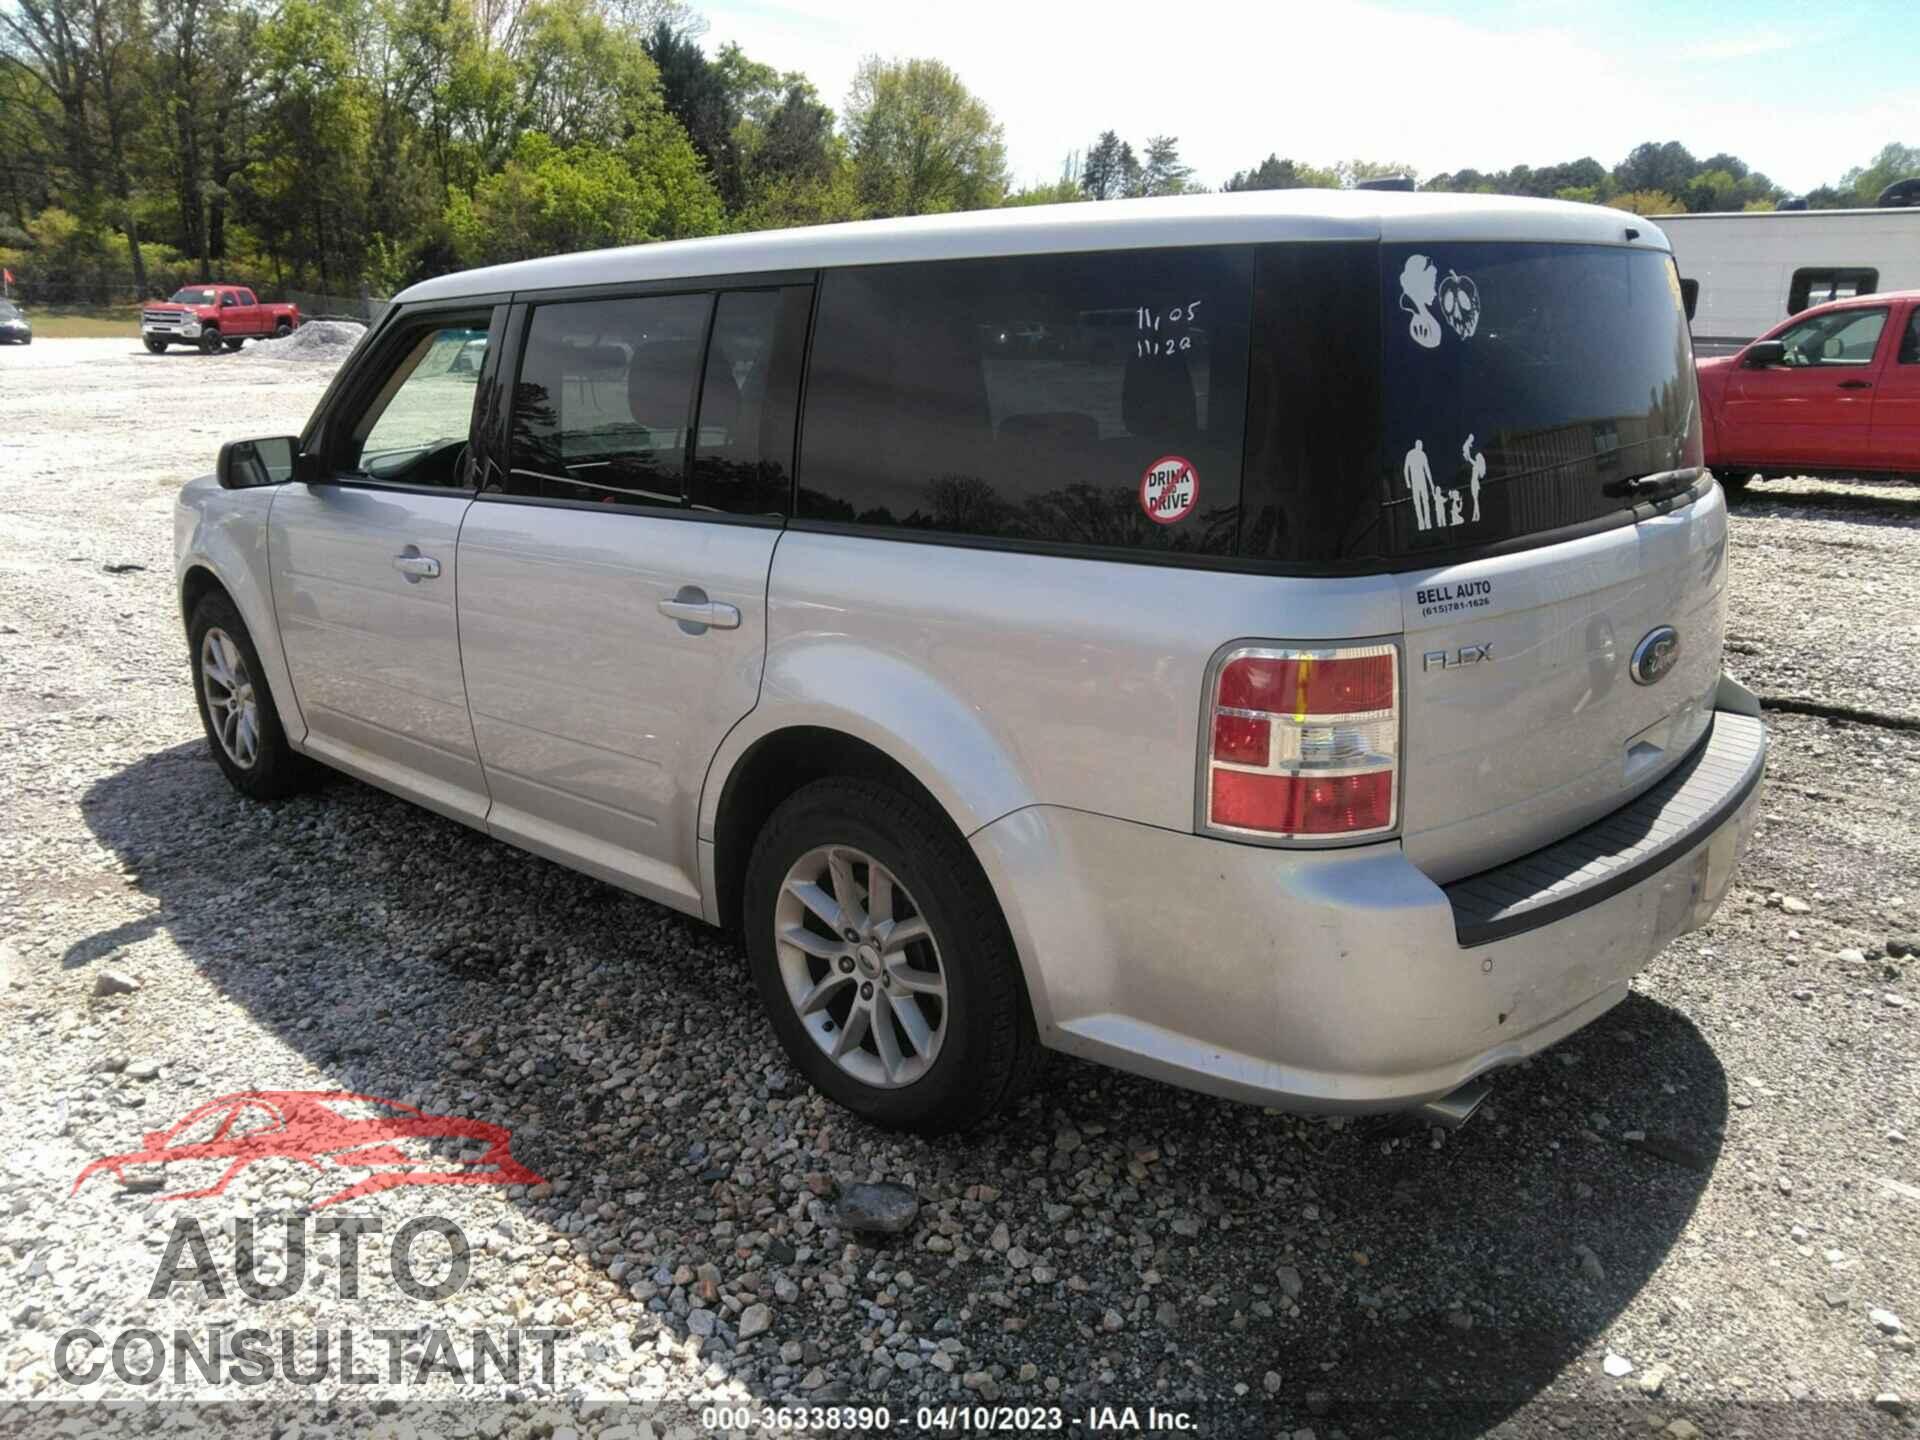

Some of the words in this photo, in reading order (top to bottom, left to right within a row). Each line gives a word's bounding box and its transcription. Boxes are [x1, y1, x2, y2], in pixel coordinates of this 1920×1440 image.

[1149, 468, 1189, 487] DRINK
[1149, 493, 1189, 511] DRIVE
[1416, 587, 1453, 604] BELL
[1456, 580, 1491, 598] AUTO
[1424, 642, 1493, 672] FLEX
